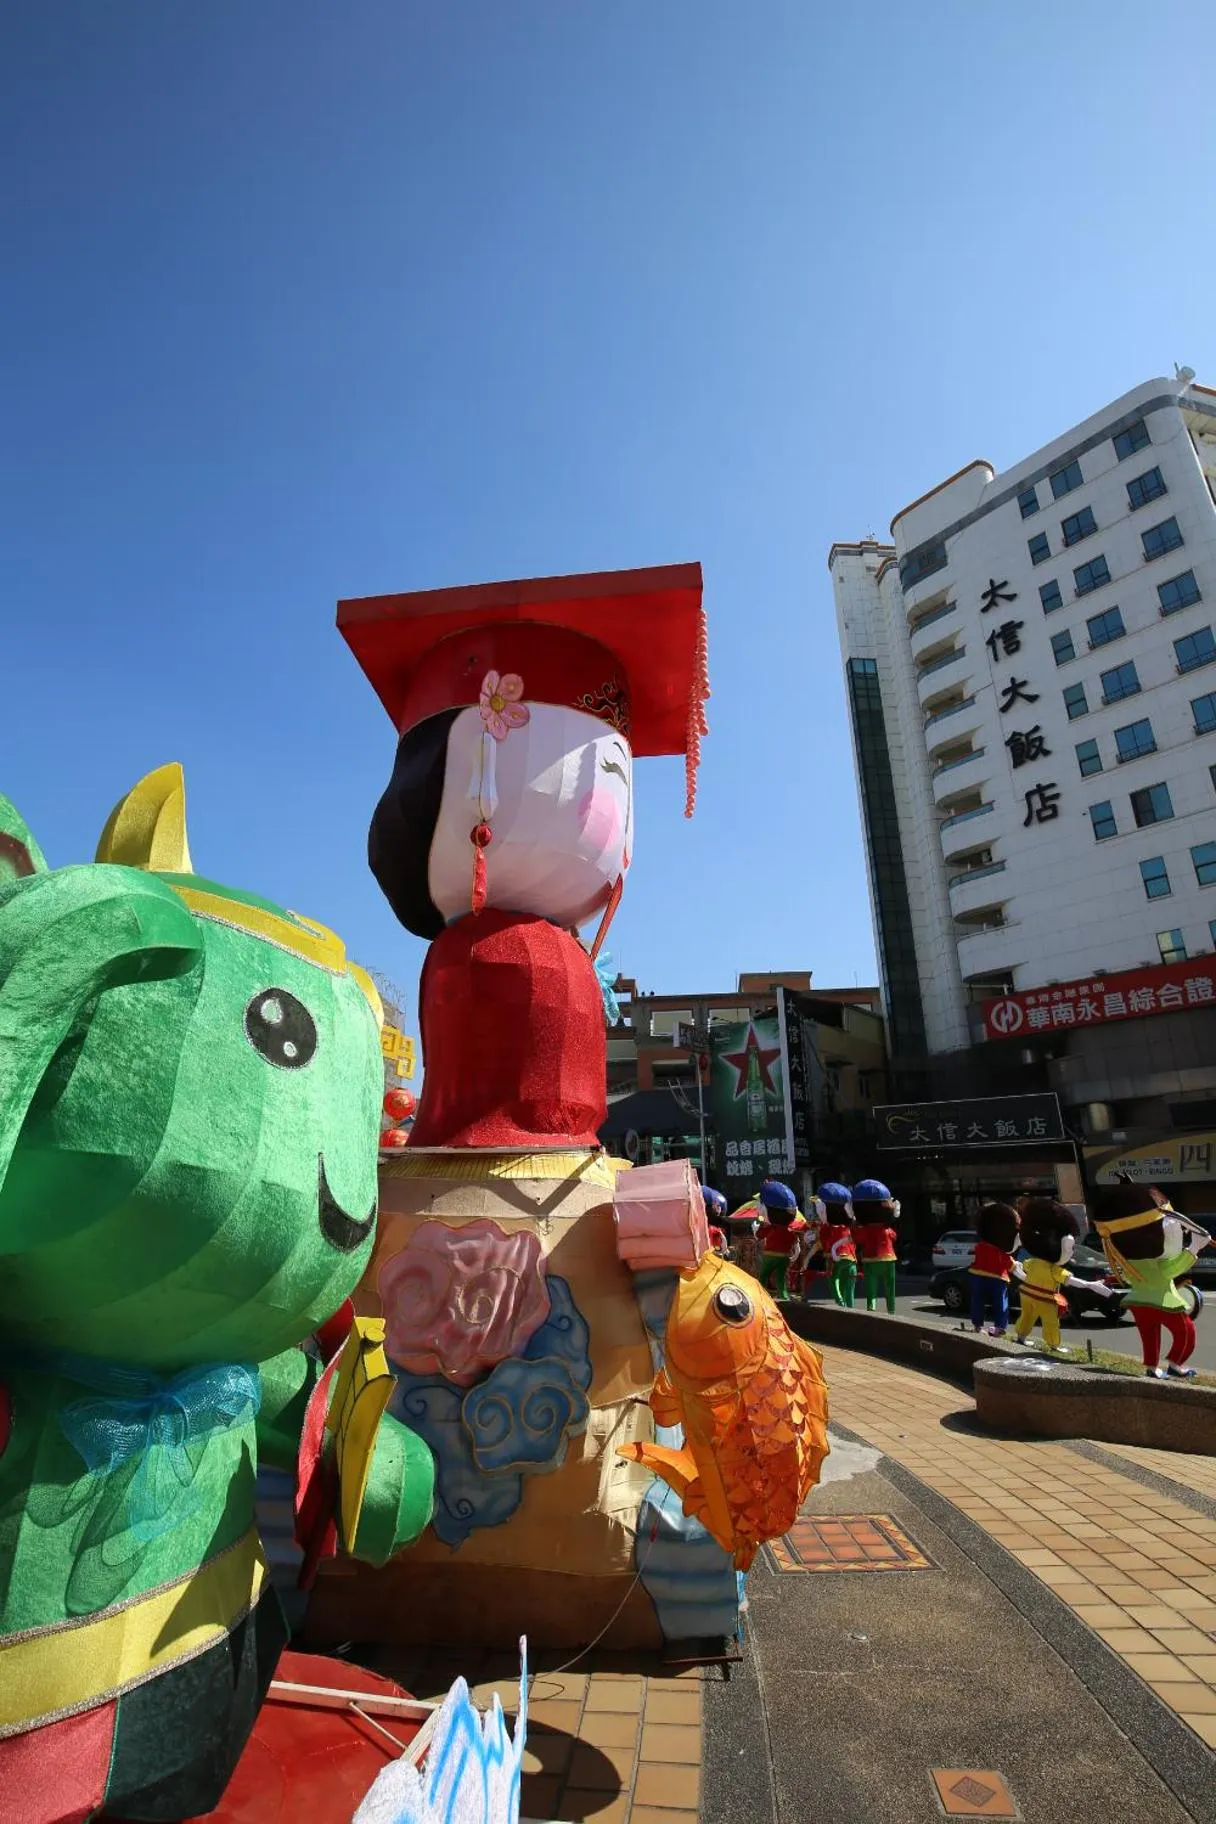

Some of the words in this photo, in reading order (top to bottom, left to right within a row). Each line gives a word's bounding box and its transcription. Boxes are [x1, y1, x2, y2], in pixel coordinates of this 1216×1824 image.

[980, 578, 1061, 827] 太信大飯店
[1025, 976, 1215, 1030] 華南永昌綜合證
[908, 1116, 1048, 1142] 太信大飯店
[1179, 1142, 1211, 1173] 四
